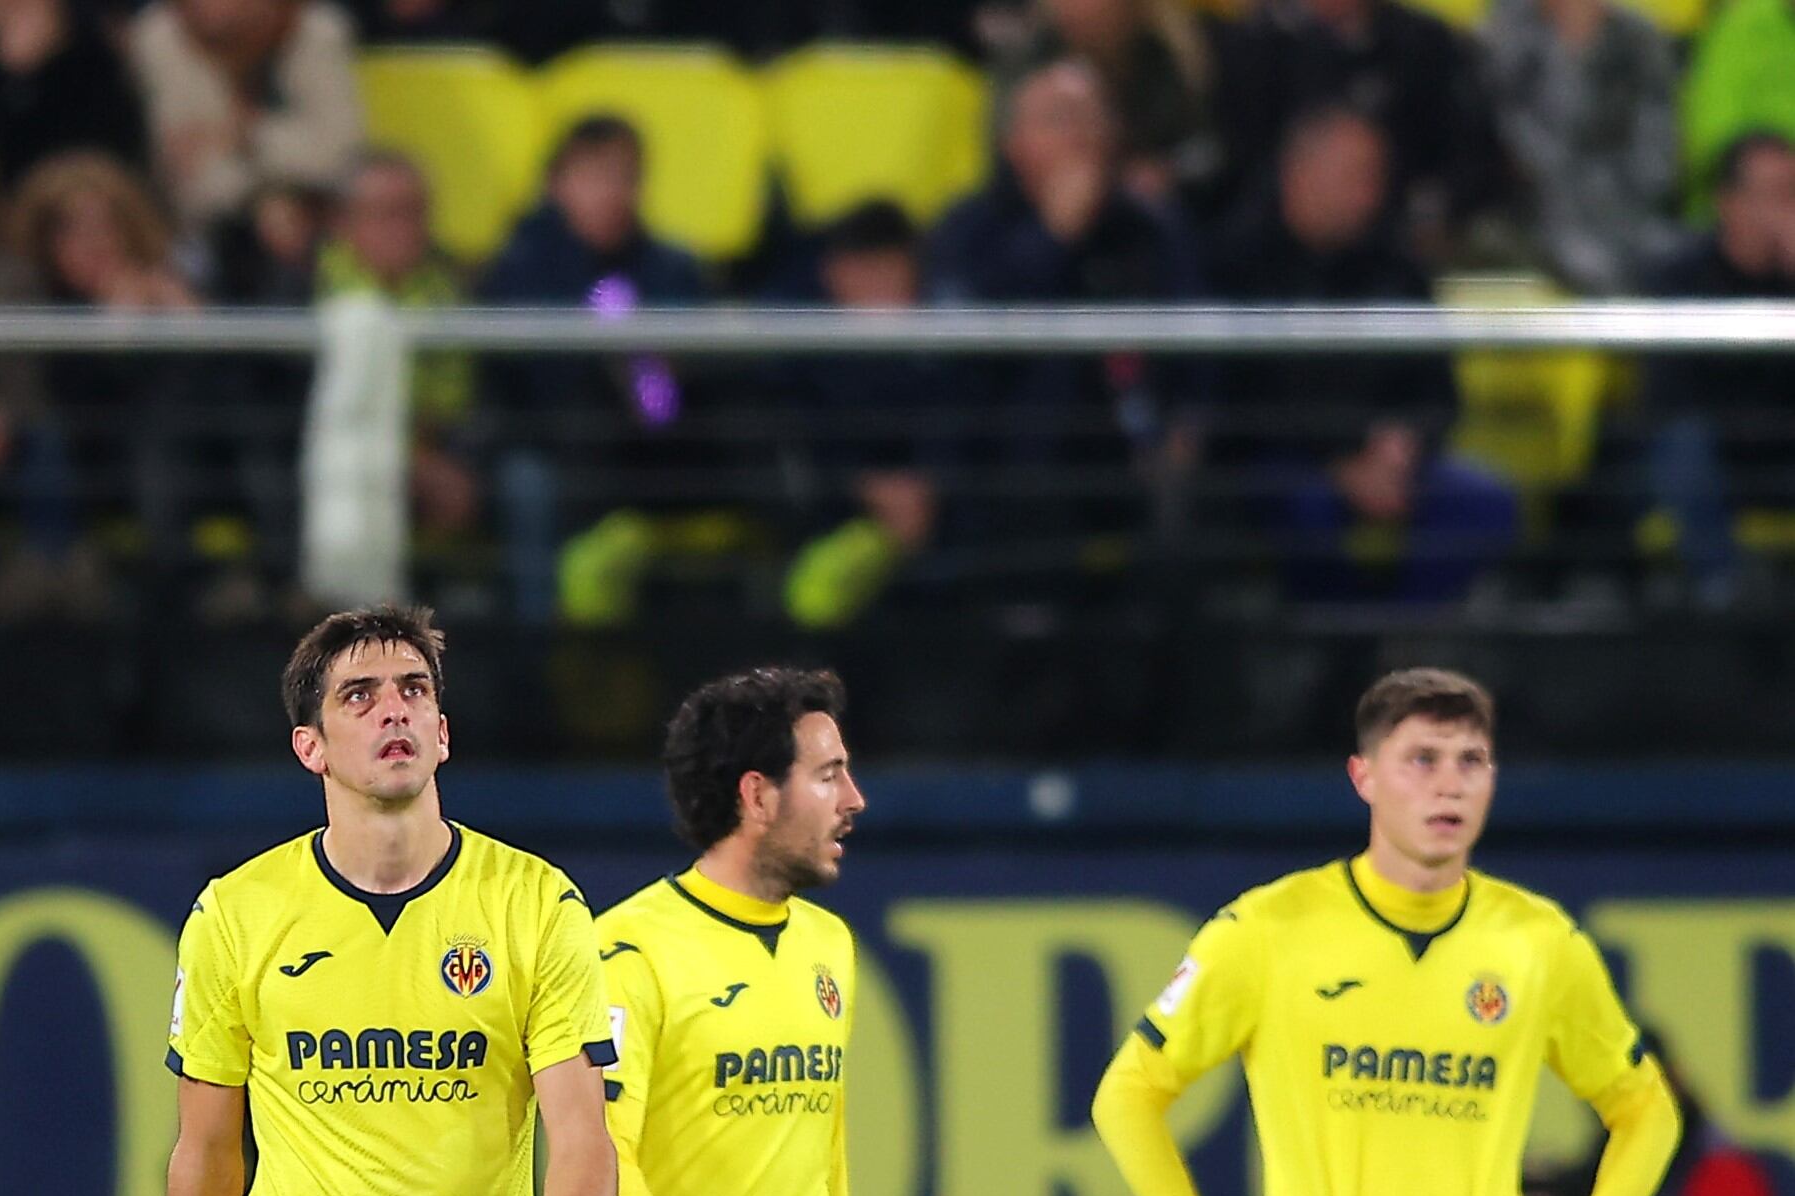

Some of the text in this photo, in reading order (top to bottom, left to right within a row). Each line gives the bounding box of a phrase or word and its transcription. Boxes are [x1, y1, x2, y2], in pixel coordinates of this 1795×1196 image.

[286, 1028, 488, 1070] PAMESA
[1323, 1044, 1496, 1090] PAMESA
[298, 1073, 479, 1104] cerámica
